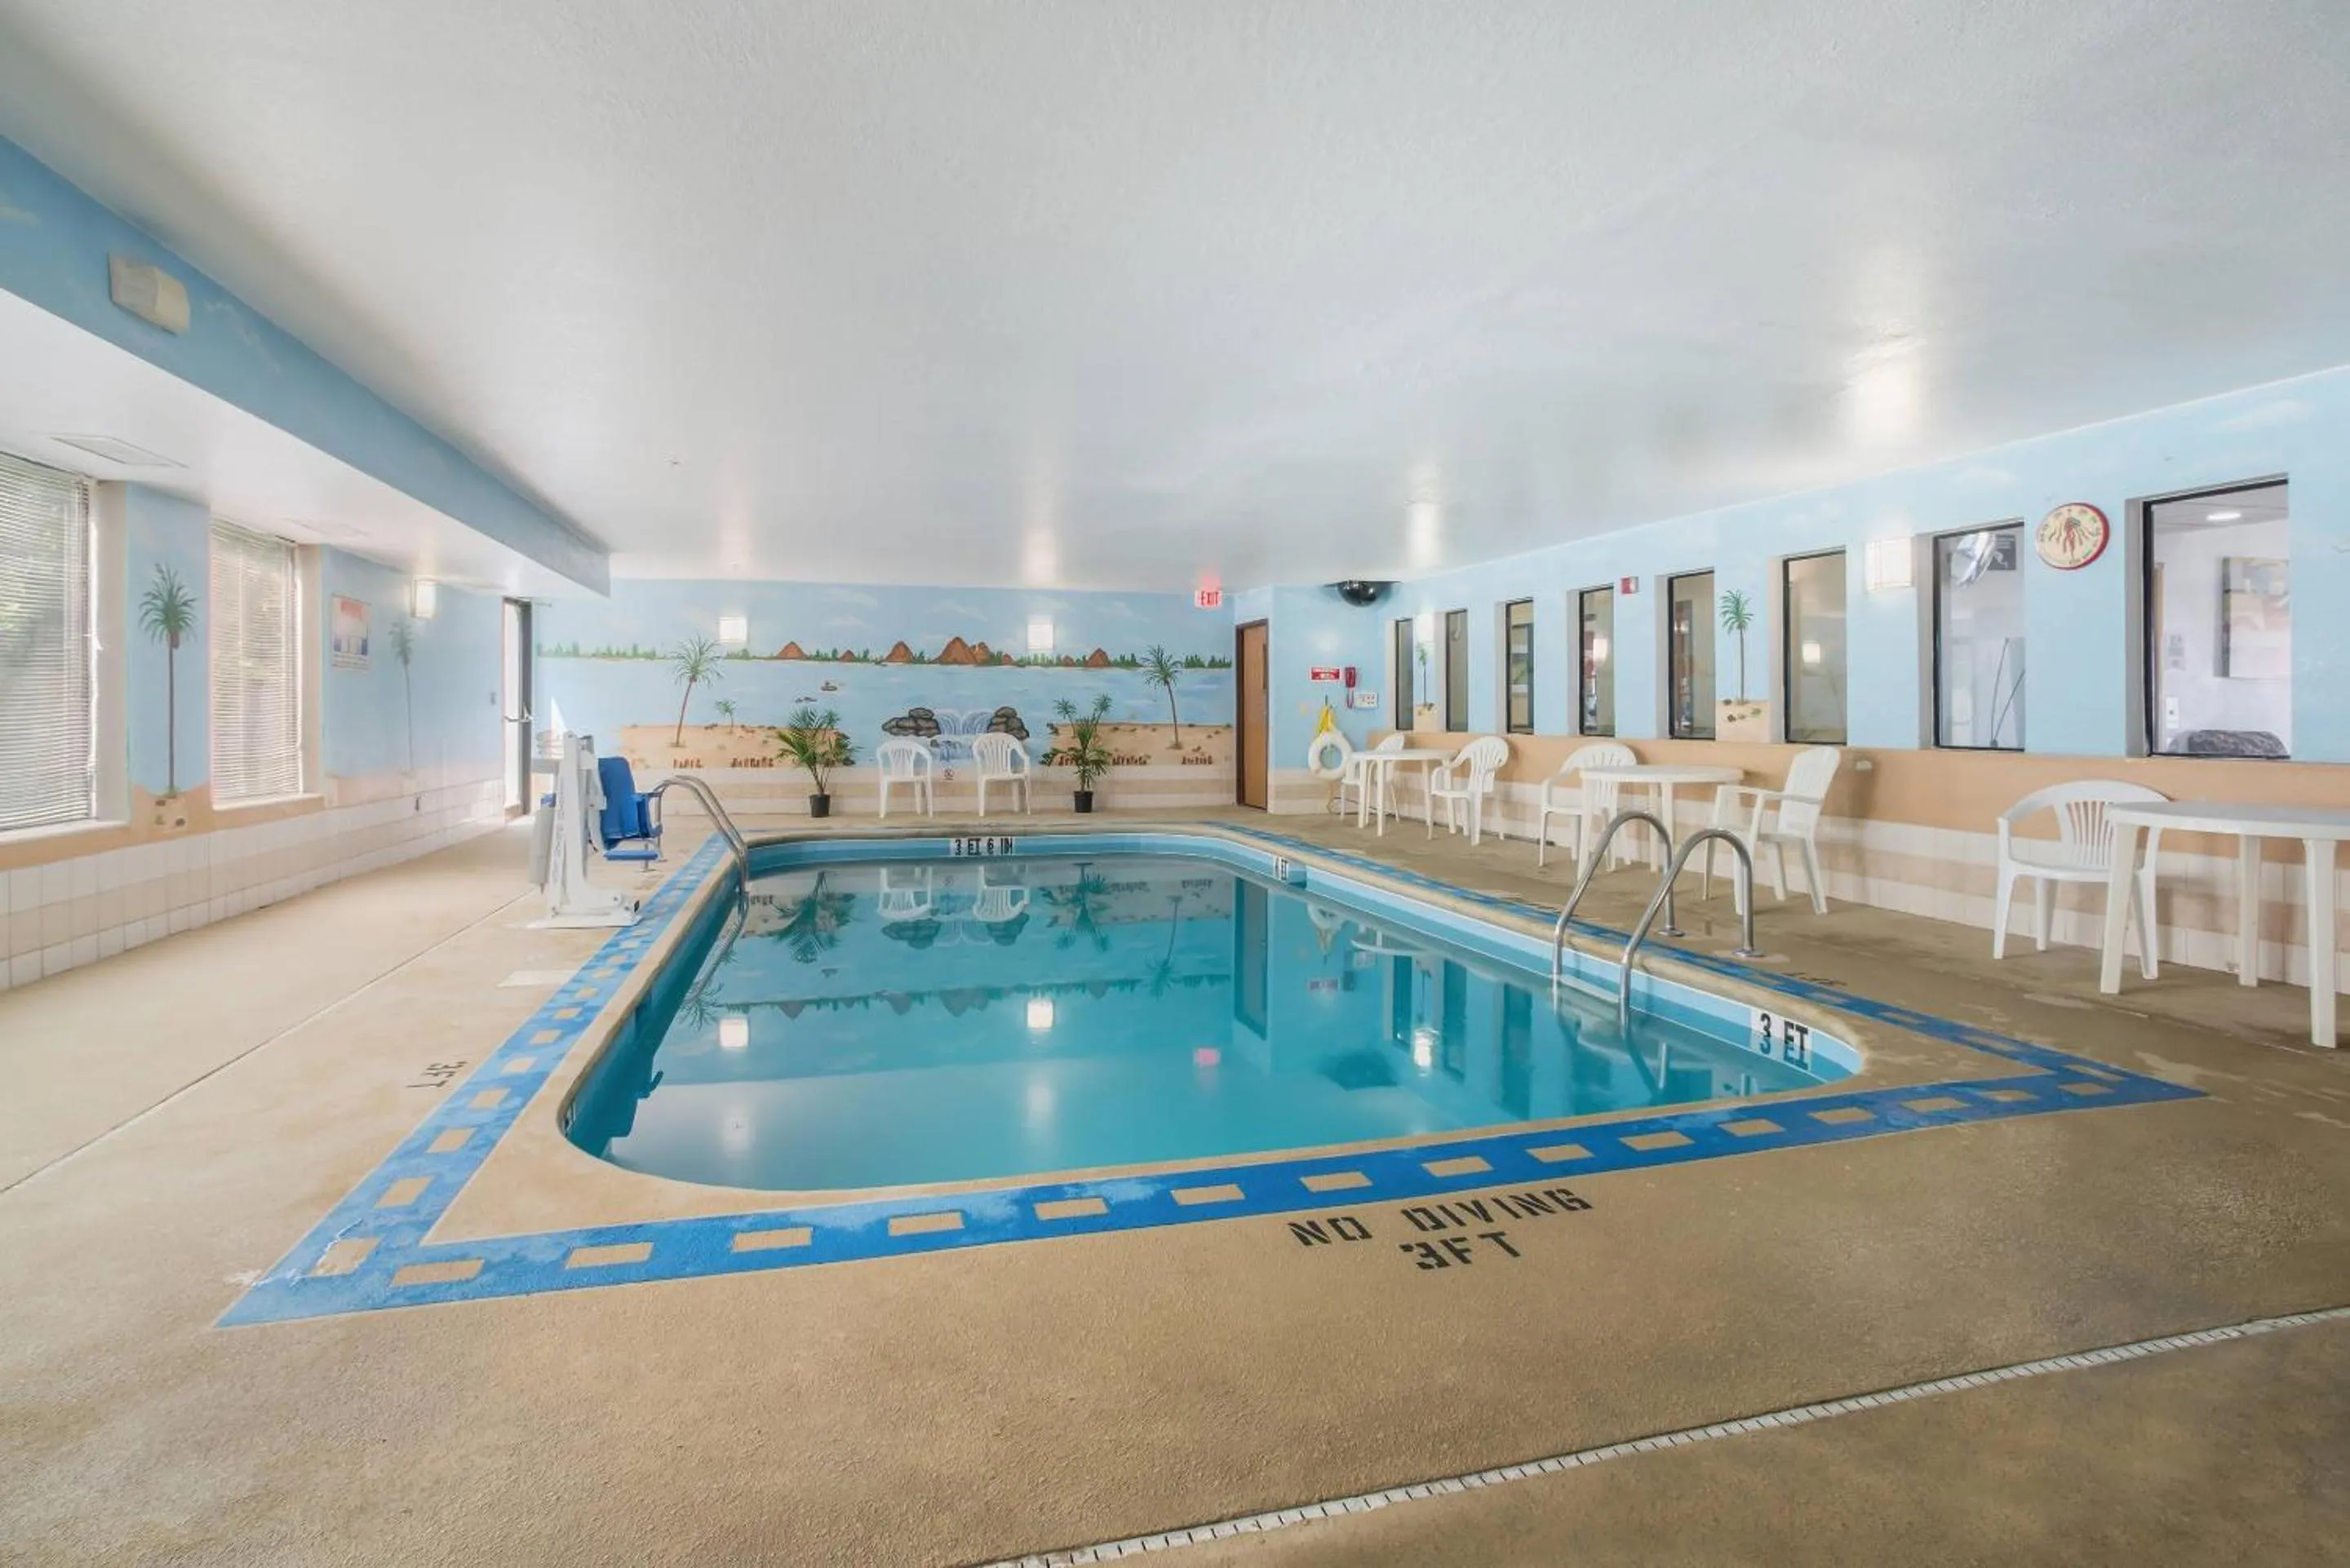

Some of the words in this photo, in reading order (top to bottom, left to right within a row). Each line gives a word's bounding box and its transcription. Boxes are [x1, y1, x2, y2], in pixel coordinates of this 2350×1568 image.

[1201, 591, 1219, 606] EXIT
[1760, 1012, 1771, 1049] 3
[1288, 1216, 1373, 1246] NO
[1401, 1188, 1594, 1232] DIVING
[1399, 1231, 1521, 1270] 3FT
